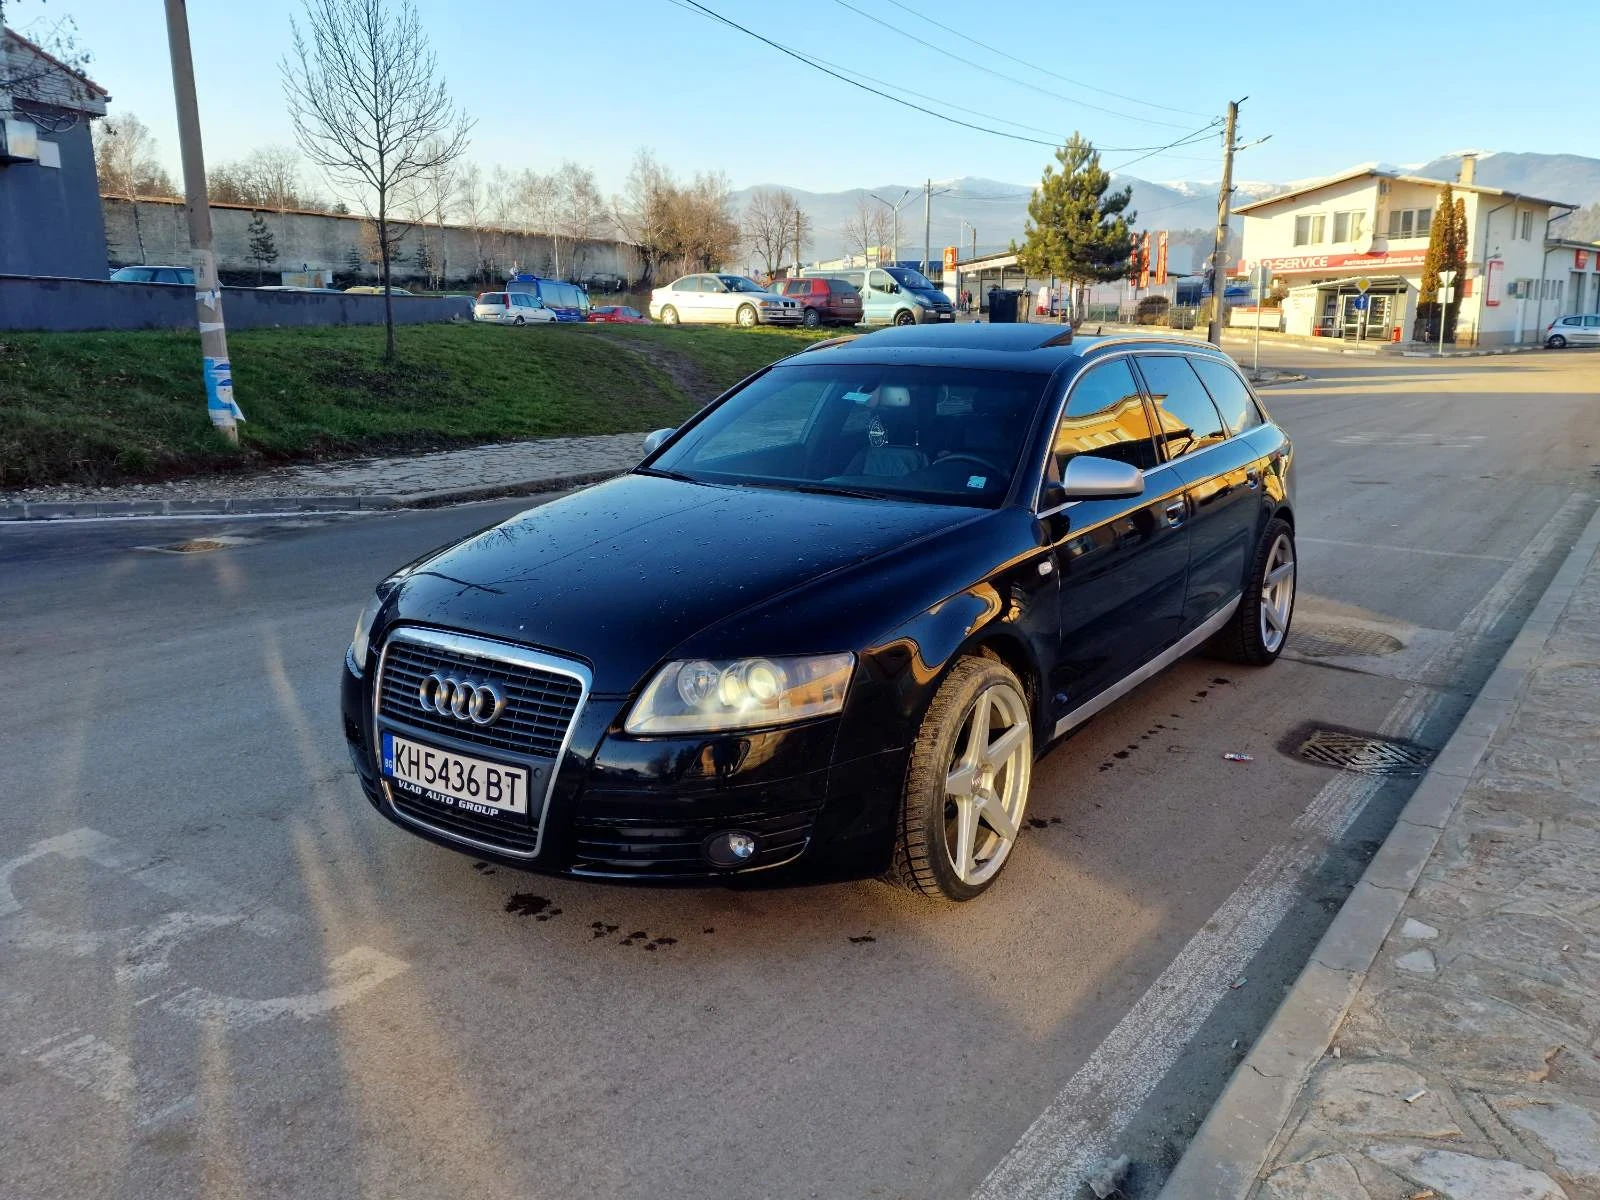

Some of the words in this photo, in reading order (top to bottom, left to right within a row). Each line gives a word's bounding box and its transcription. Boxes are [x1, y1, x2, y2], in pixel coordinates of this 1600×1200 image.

[384, 758, 393, 769] BG
[398, 779, 422, 795] VLAD
[425, 790, 454, 806] AUTO
[458, 799, 499, 817] GROUP
